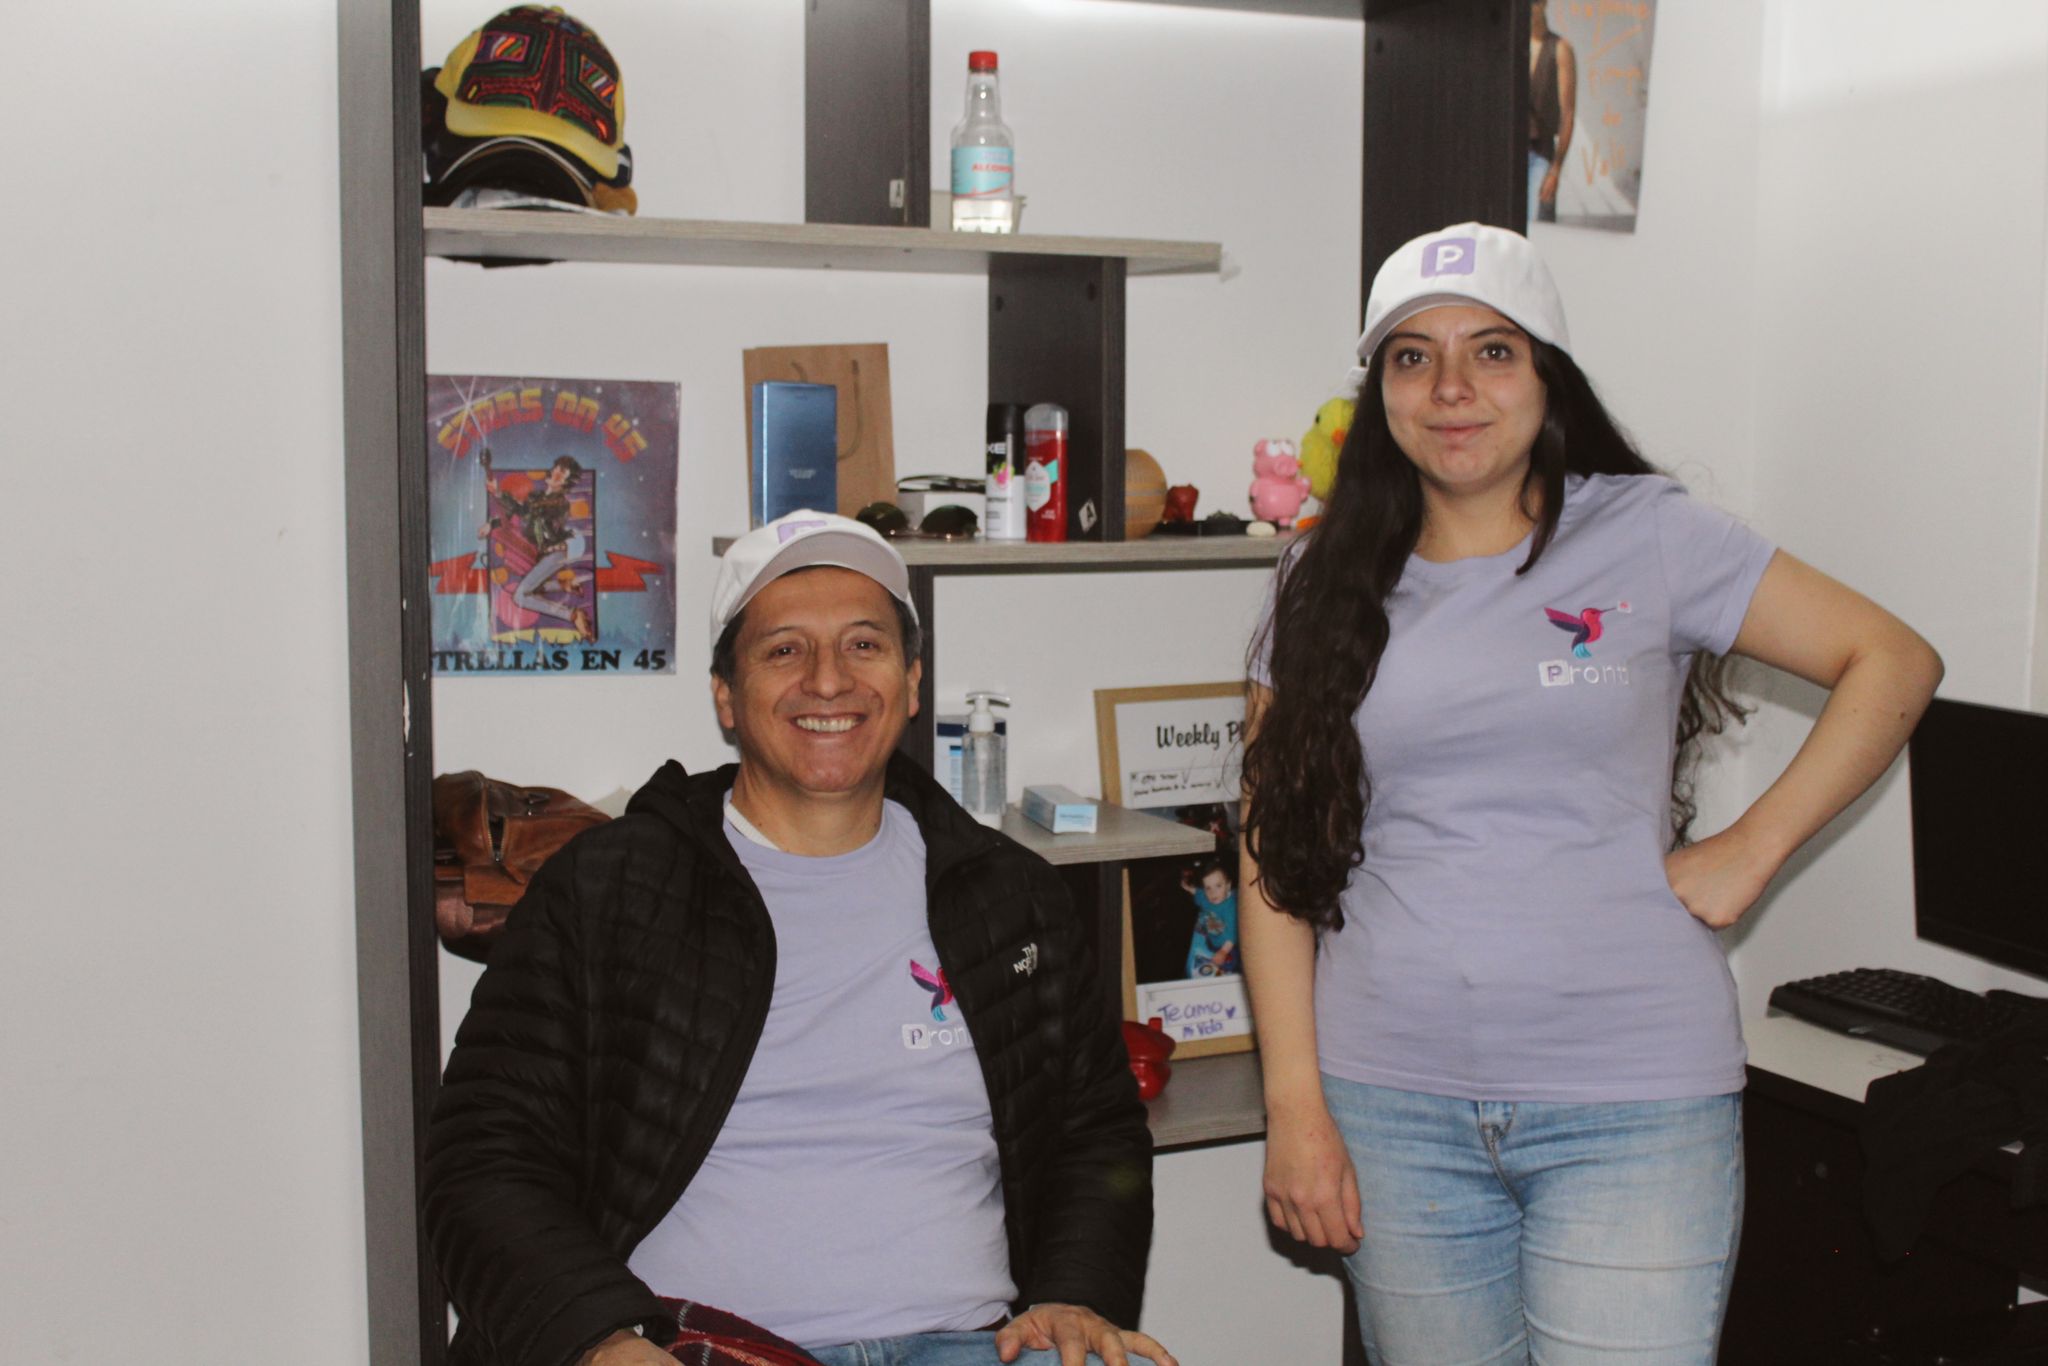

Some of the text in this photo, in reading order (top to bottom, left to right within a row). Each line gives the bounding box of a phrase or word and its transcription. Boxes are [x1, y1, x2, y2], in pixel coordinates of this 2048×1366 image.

[1435, 244, 1464, 273] P
[987, 441, 1006, 454] XE
[432, 648, 667, 672] TRELLAS EN 45
[1156, 719, 1246, 750] Weekly Pl
[908, 1026, 968, 1047] Pron
